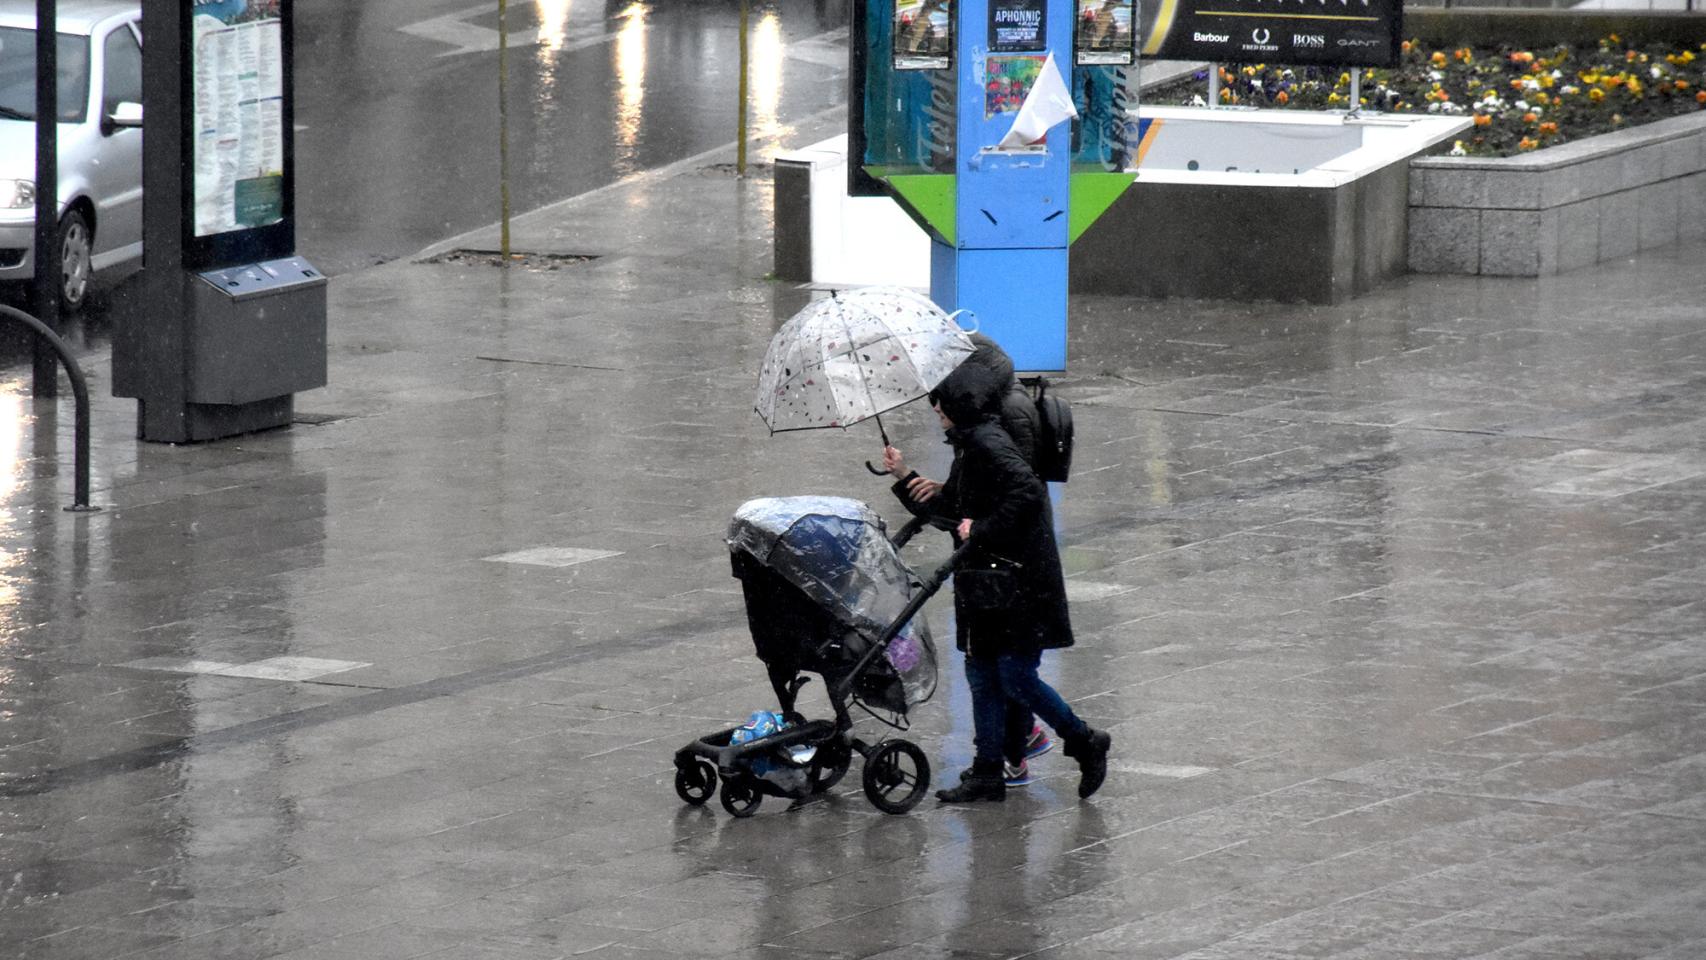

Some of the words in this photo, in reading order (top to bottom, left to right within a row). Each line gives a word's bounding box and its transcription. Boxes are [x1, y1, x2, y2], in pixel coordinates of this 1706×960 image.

[995, 10, 1041, 23] APHONNIC
[1193, 32, 1230, 43] Barbour
[1293, 33, 1325, 45] BOSS
[1336, 38, 1380, 47] GANT
